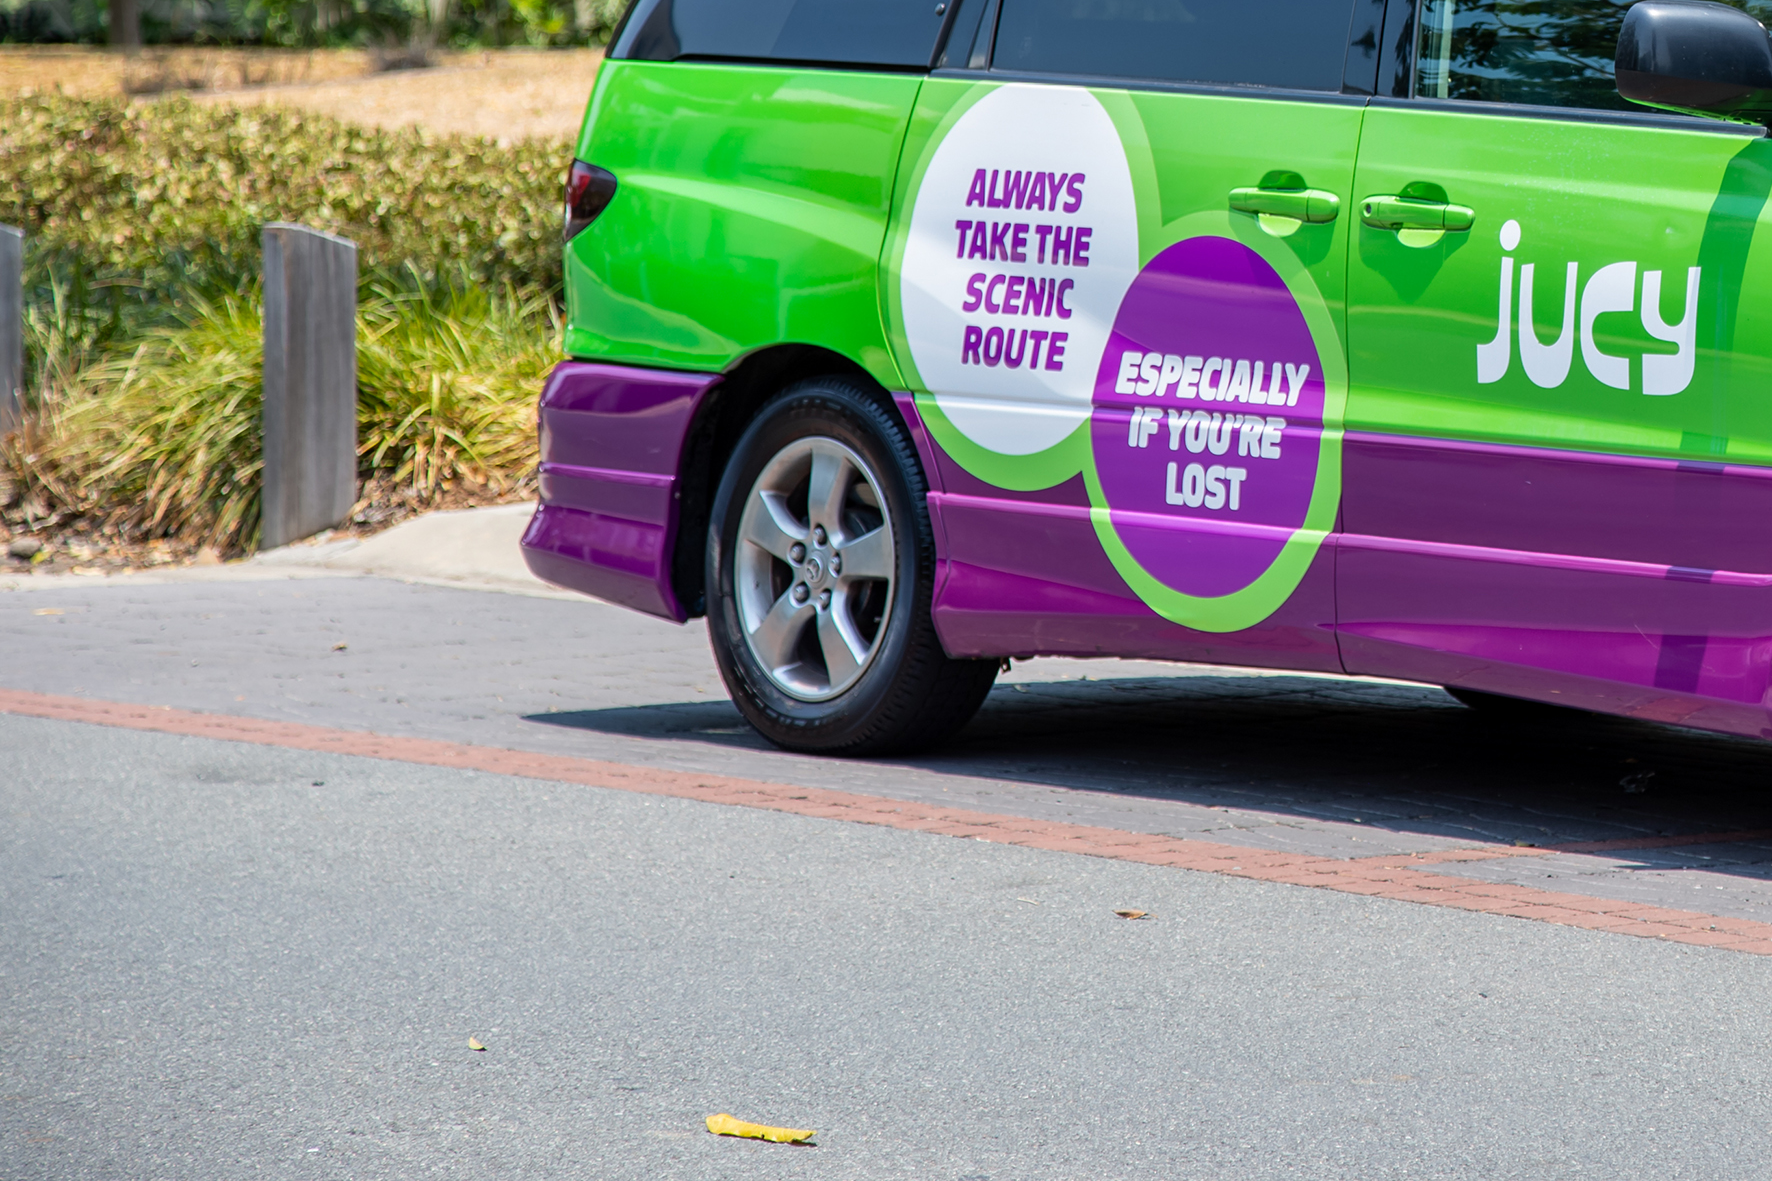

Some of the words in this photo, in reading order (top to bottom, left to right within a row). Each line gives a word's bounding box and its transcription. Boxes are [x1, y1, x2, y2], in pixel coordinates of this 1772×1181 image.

[965, 168, 1085, 213] ALWAYS
[955, 220, 1029, 263] TAKE
[1035, 224, 1092, 268] THE
[962, 273, 1074, 319] SCENIC
[1476, 219, 1701, 396] jucy
[961, 325, 1068, 371] ROUTE
[1114, 351, 1309, 407] ESPECIALLY
[1127, 405, 1162, 449] IF
[1167, 409, 1286, 460] YOU'RE
[1165, 462, 1247, 511] LOST
